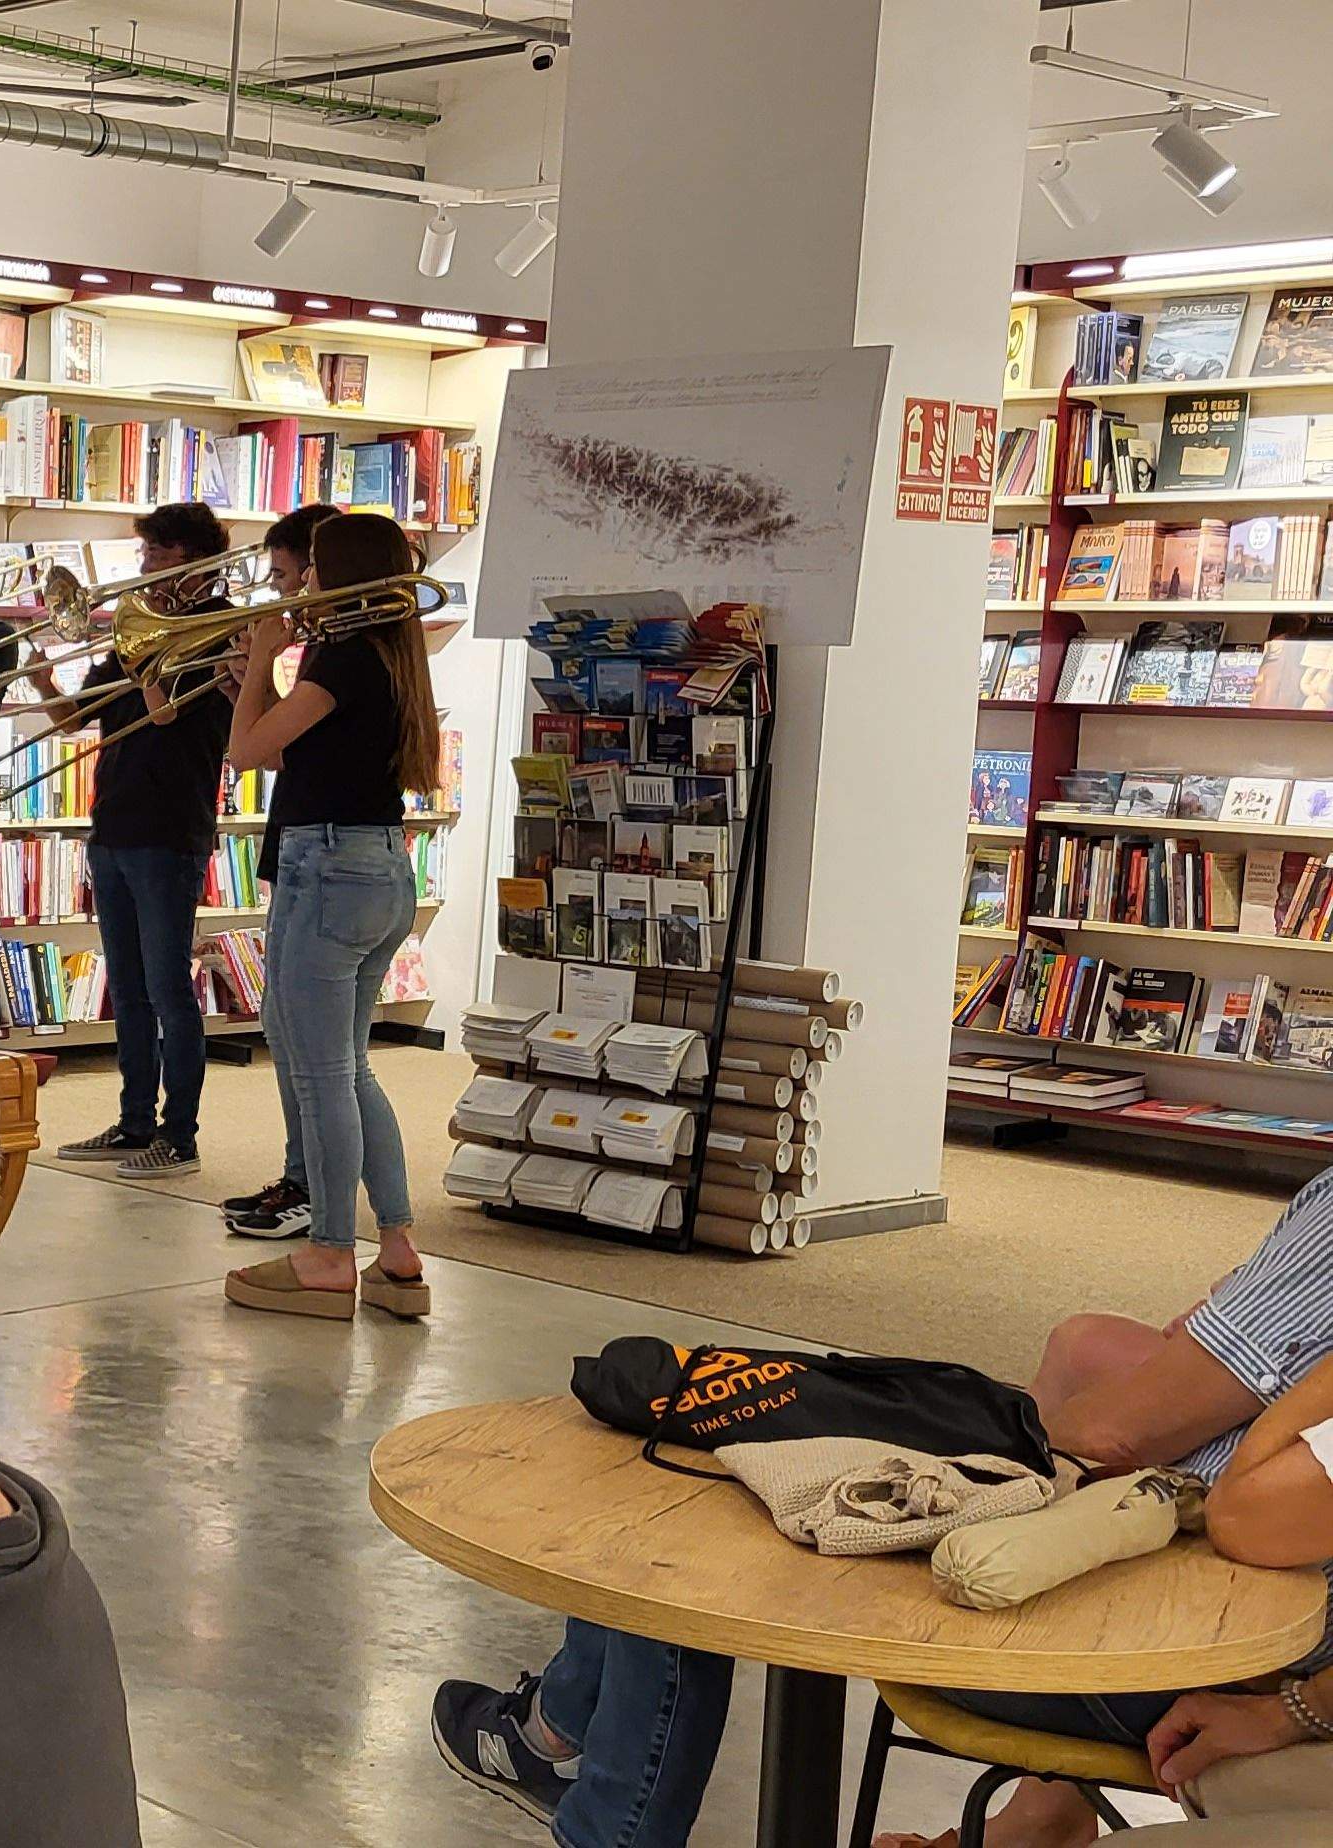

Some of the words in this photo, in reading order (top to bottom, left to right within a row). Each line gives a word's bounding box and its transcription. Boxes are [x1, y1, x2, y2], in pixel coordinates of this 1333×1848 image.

[1169, 303, 1240, 315] PAISAJES
[1211, 399, 1240, 411] ERES
[1171, 411, 1209, 424] ANTES
[1212, 411, 1239, 423] QUE
[1171, 423, 1209, 435] TODO
[898, 492, 942, 513] EXTINTOR
[952, 491, 974, 504] BOCA
[976, 493, 987, 506] DE
[948, 506, 987, 519] INCENDIO
[691, 1413, 732, 1436] TIME
[732, 1405, 756, 1422] TO
[758, 1387, 799, 1414] PLAY
